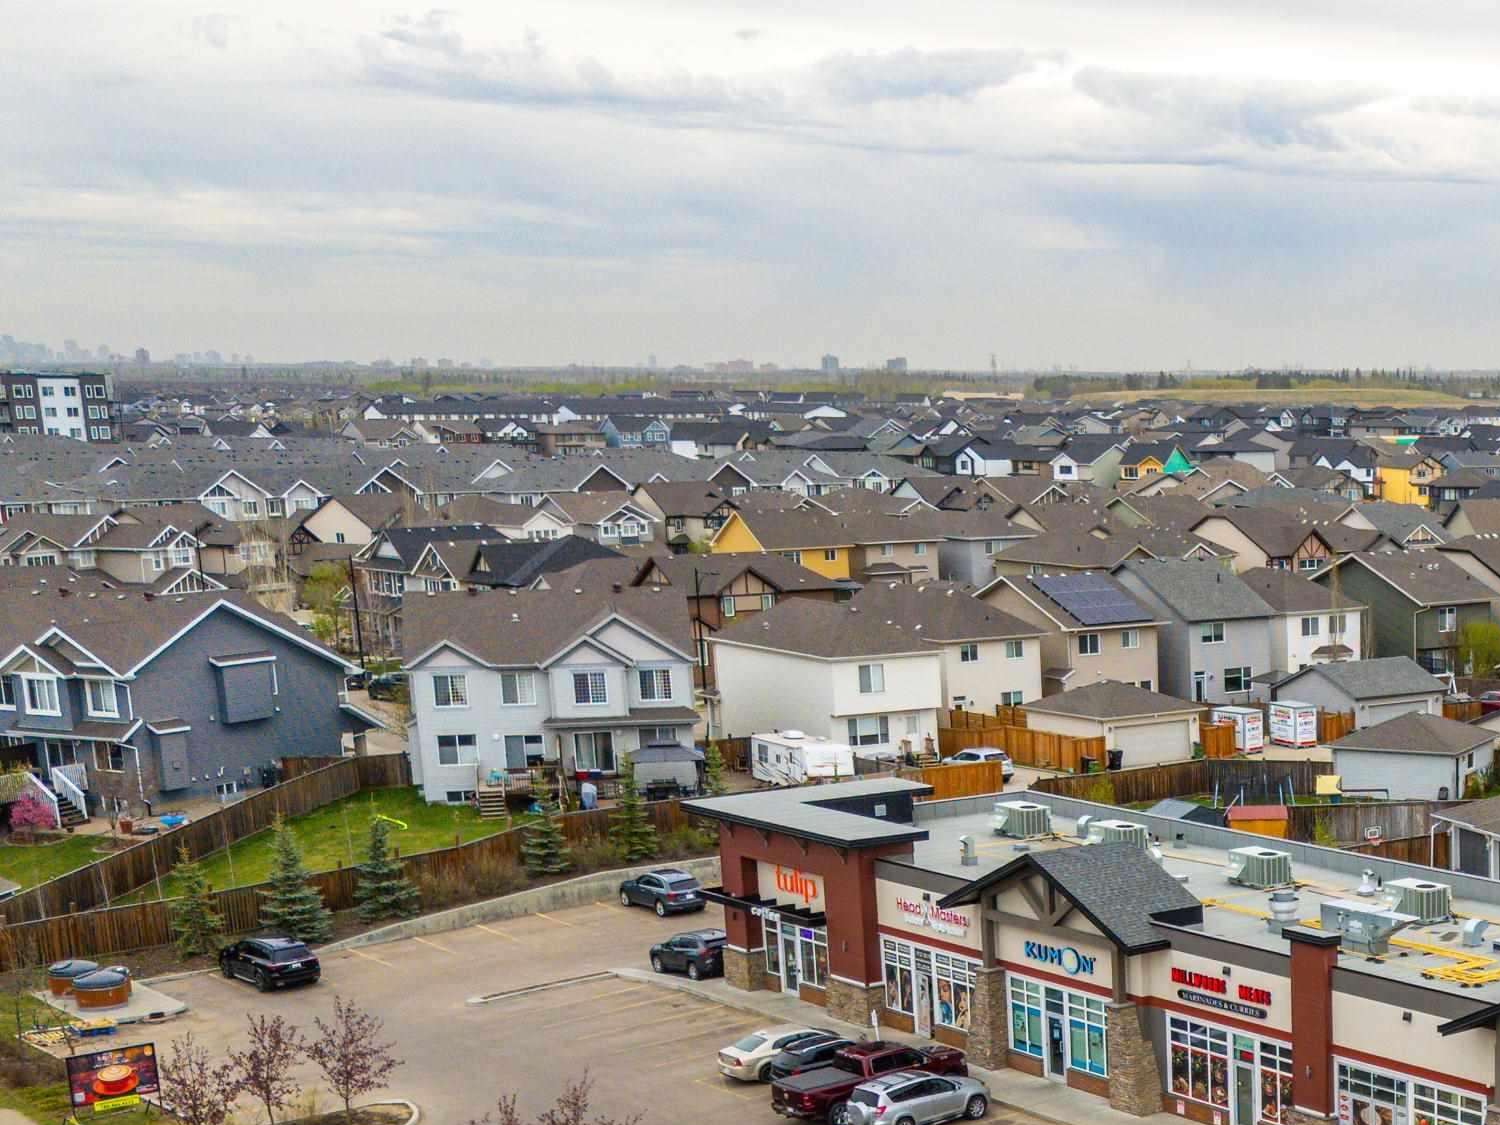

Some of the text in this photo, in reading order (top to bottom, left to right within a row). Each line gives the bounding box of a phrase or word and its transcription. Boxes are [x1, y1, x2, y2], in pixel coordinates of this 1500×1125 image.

[774, 864, 817, 904] tulip
[896, 897, 921, 915] Head
[930, 904, 968, 928] Masters
[1024, 940, 1095, 975] KUMON
